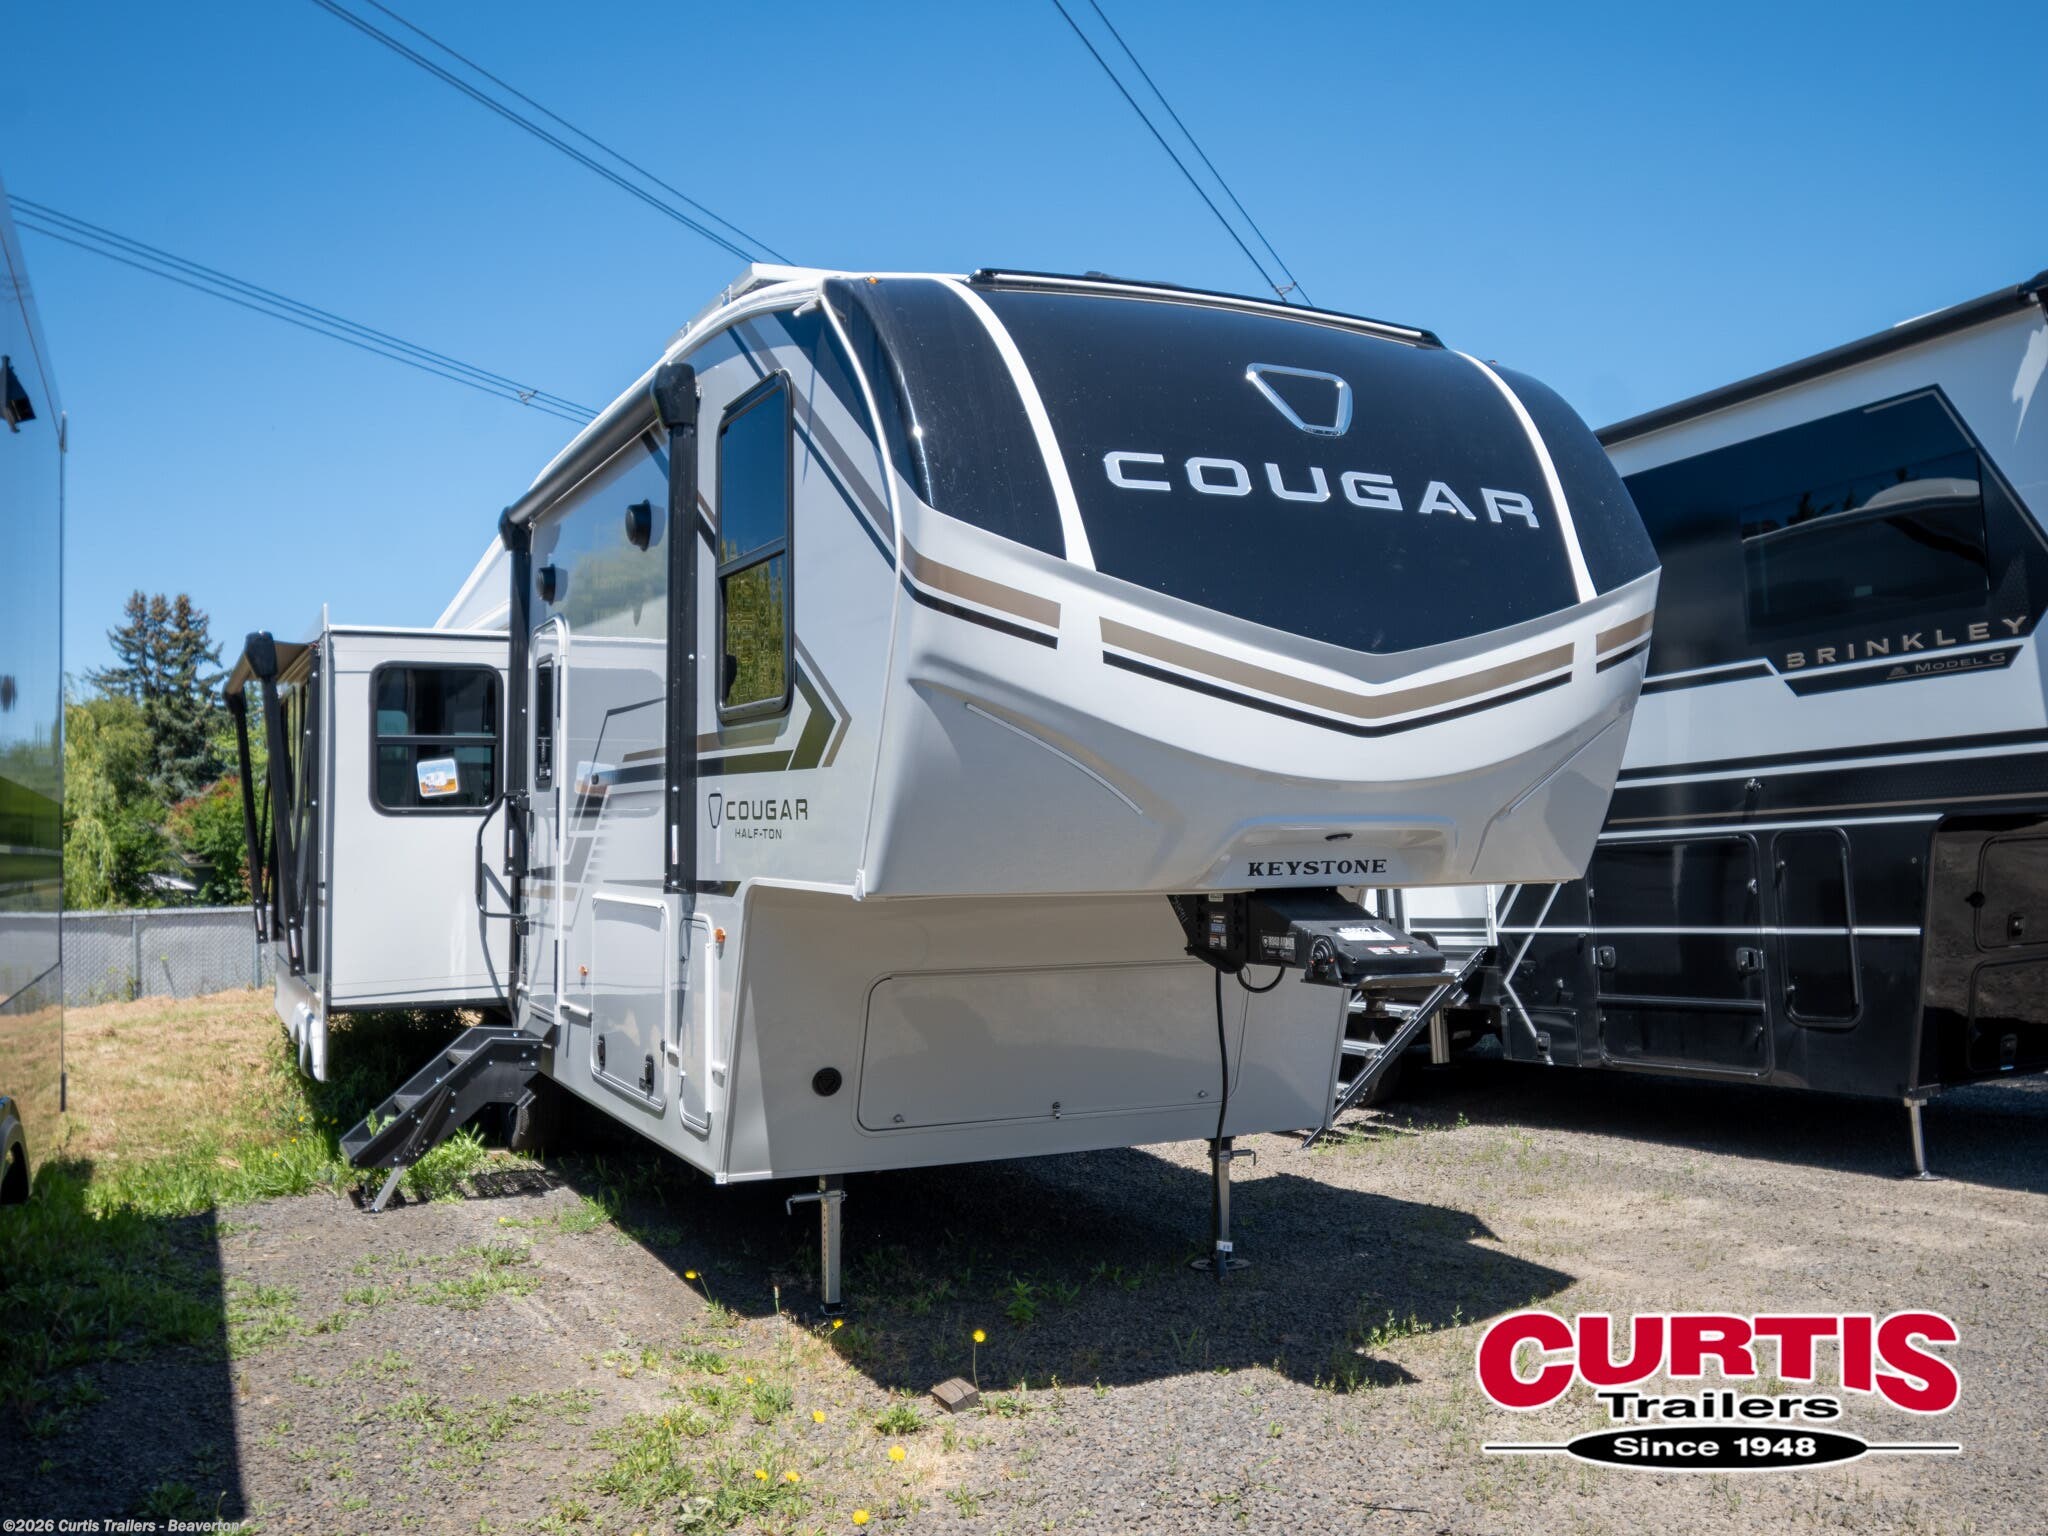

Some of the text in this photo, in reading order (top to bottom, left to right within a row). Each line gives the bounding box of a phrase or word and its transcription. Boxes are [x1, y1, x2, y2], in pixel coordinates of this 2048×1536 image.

[1102, 450, 1540, 529] COUGAR
[1786, 615, 2027, 670] BRINKLEY
[726, 798, 808, 821] COUGAR
[734, 828, 782, 840] HALF-TON
[1248, 858, 1388, 878] KEYSTONE
